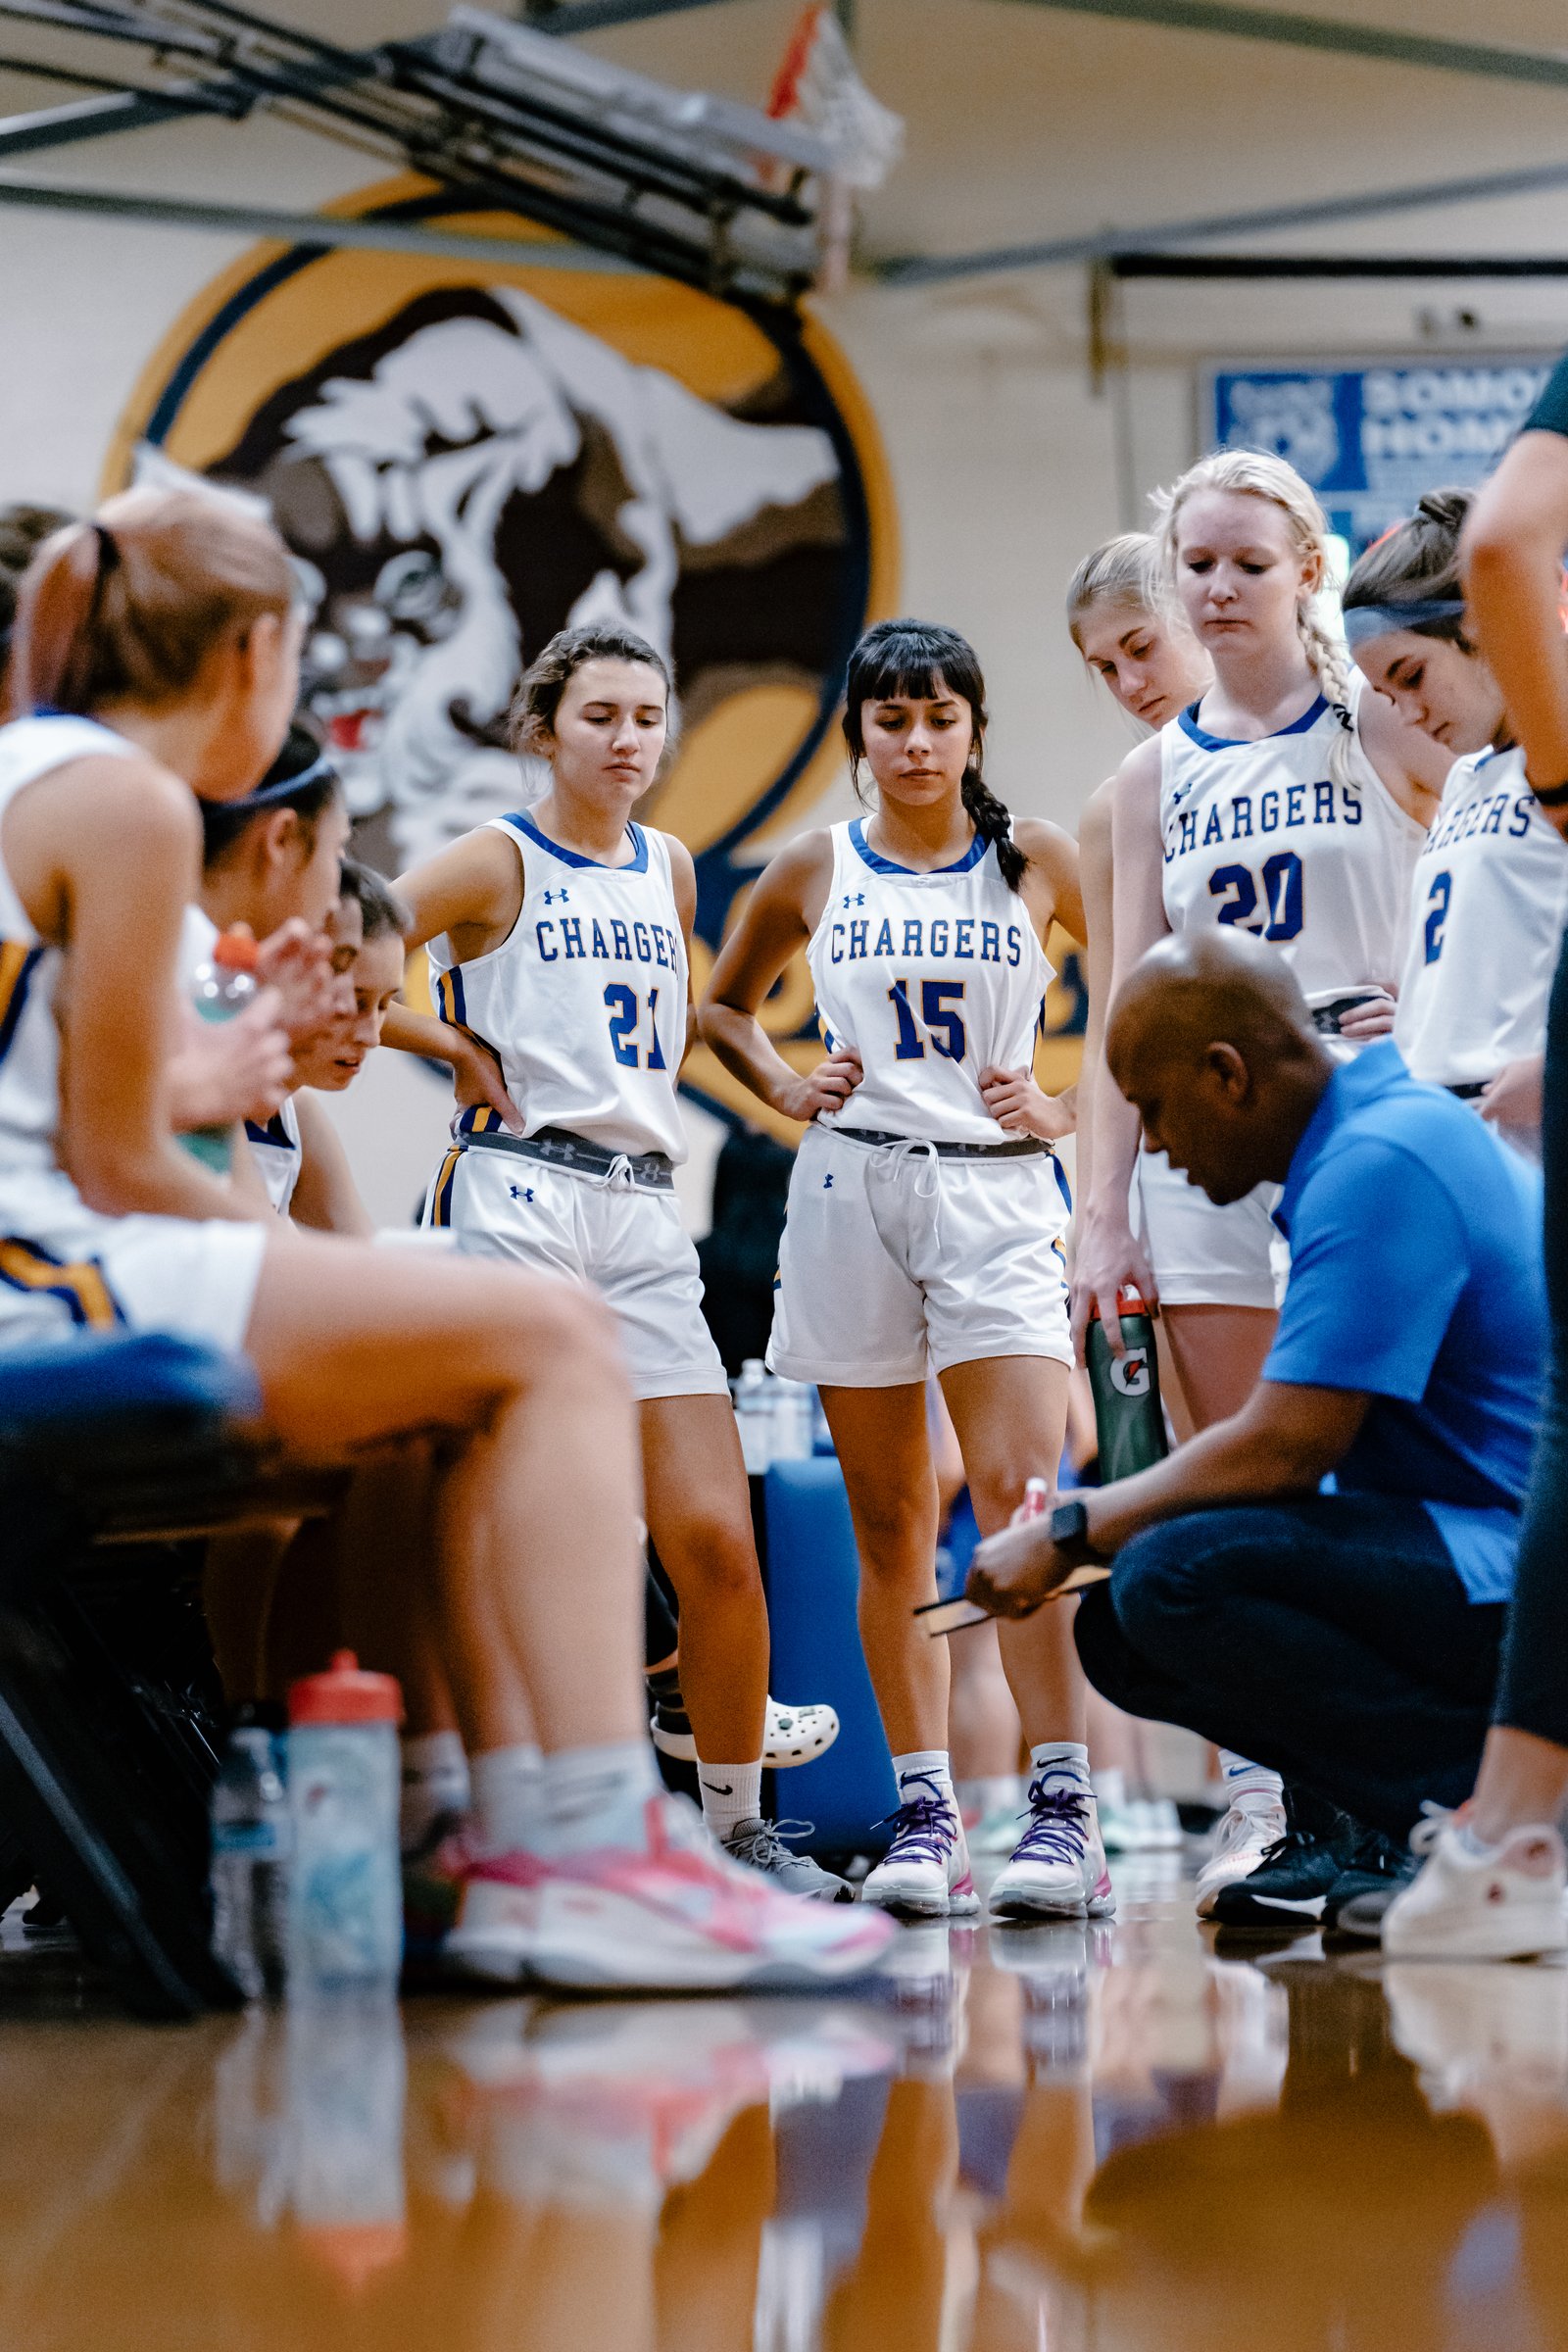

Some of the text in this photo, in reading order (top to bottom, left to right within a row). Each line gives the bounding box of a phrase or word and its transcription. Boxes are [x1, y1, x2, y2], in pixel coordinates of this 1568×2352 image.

[1207, 850, 1303, 943] 20
[1424, 869, 1453, 965] 2
[536, 917, 678, 976] CHARGER
[831, 918, 1021, 967] CHARGERS
[602, 981, 667, 1071] 21
[887, 978, 967, 1064] 15
[1109, 1348, 1151, 1396] G
